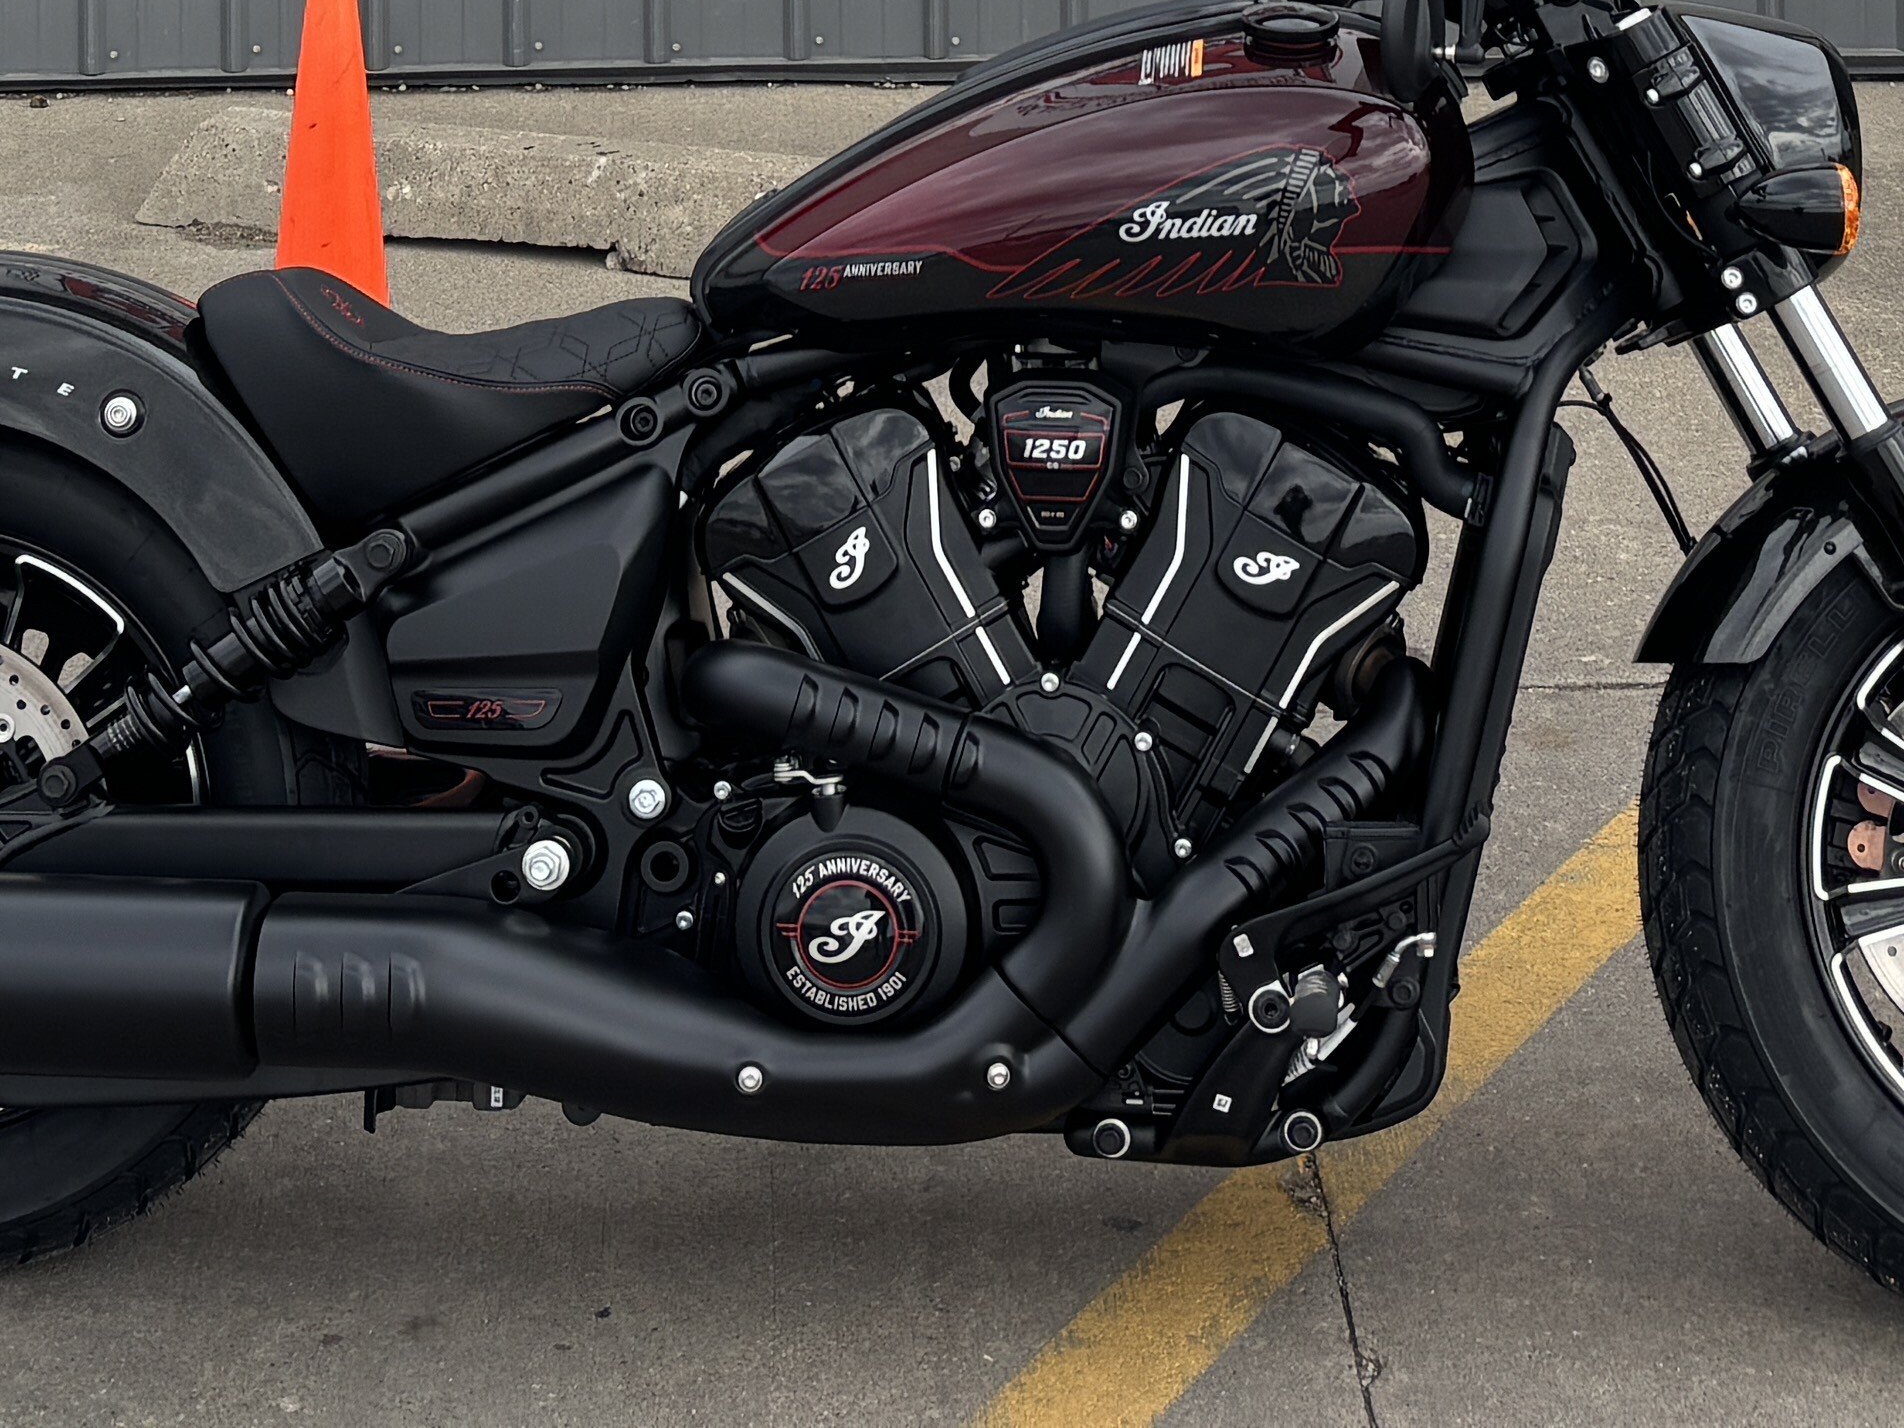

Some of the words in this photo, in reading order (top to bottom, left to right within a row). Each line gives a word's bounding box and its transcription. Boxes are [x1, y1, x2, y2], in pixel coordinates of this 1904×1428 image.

[1118, 200, 1258, 243] Indian
[843, 260, 923, 278] ANNIVERSARY
[1023, 438, 1087, 460] 1250
[466, 700, 504, 719] 125
[792, 865, 816, 899] 125
[818, 857, 912, 904] ANNIVERSARY
[786, 965, 878, 1012] ESTABLISHED
[878, 971, 907, 1001] 1901
